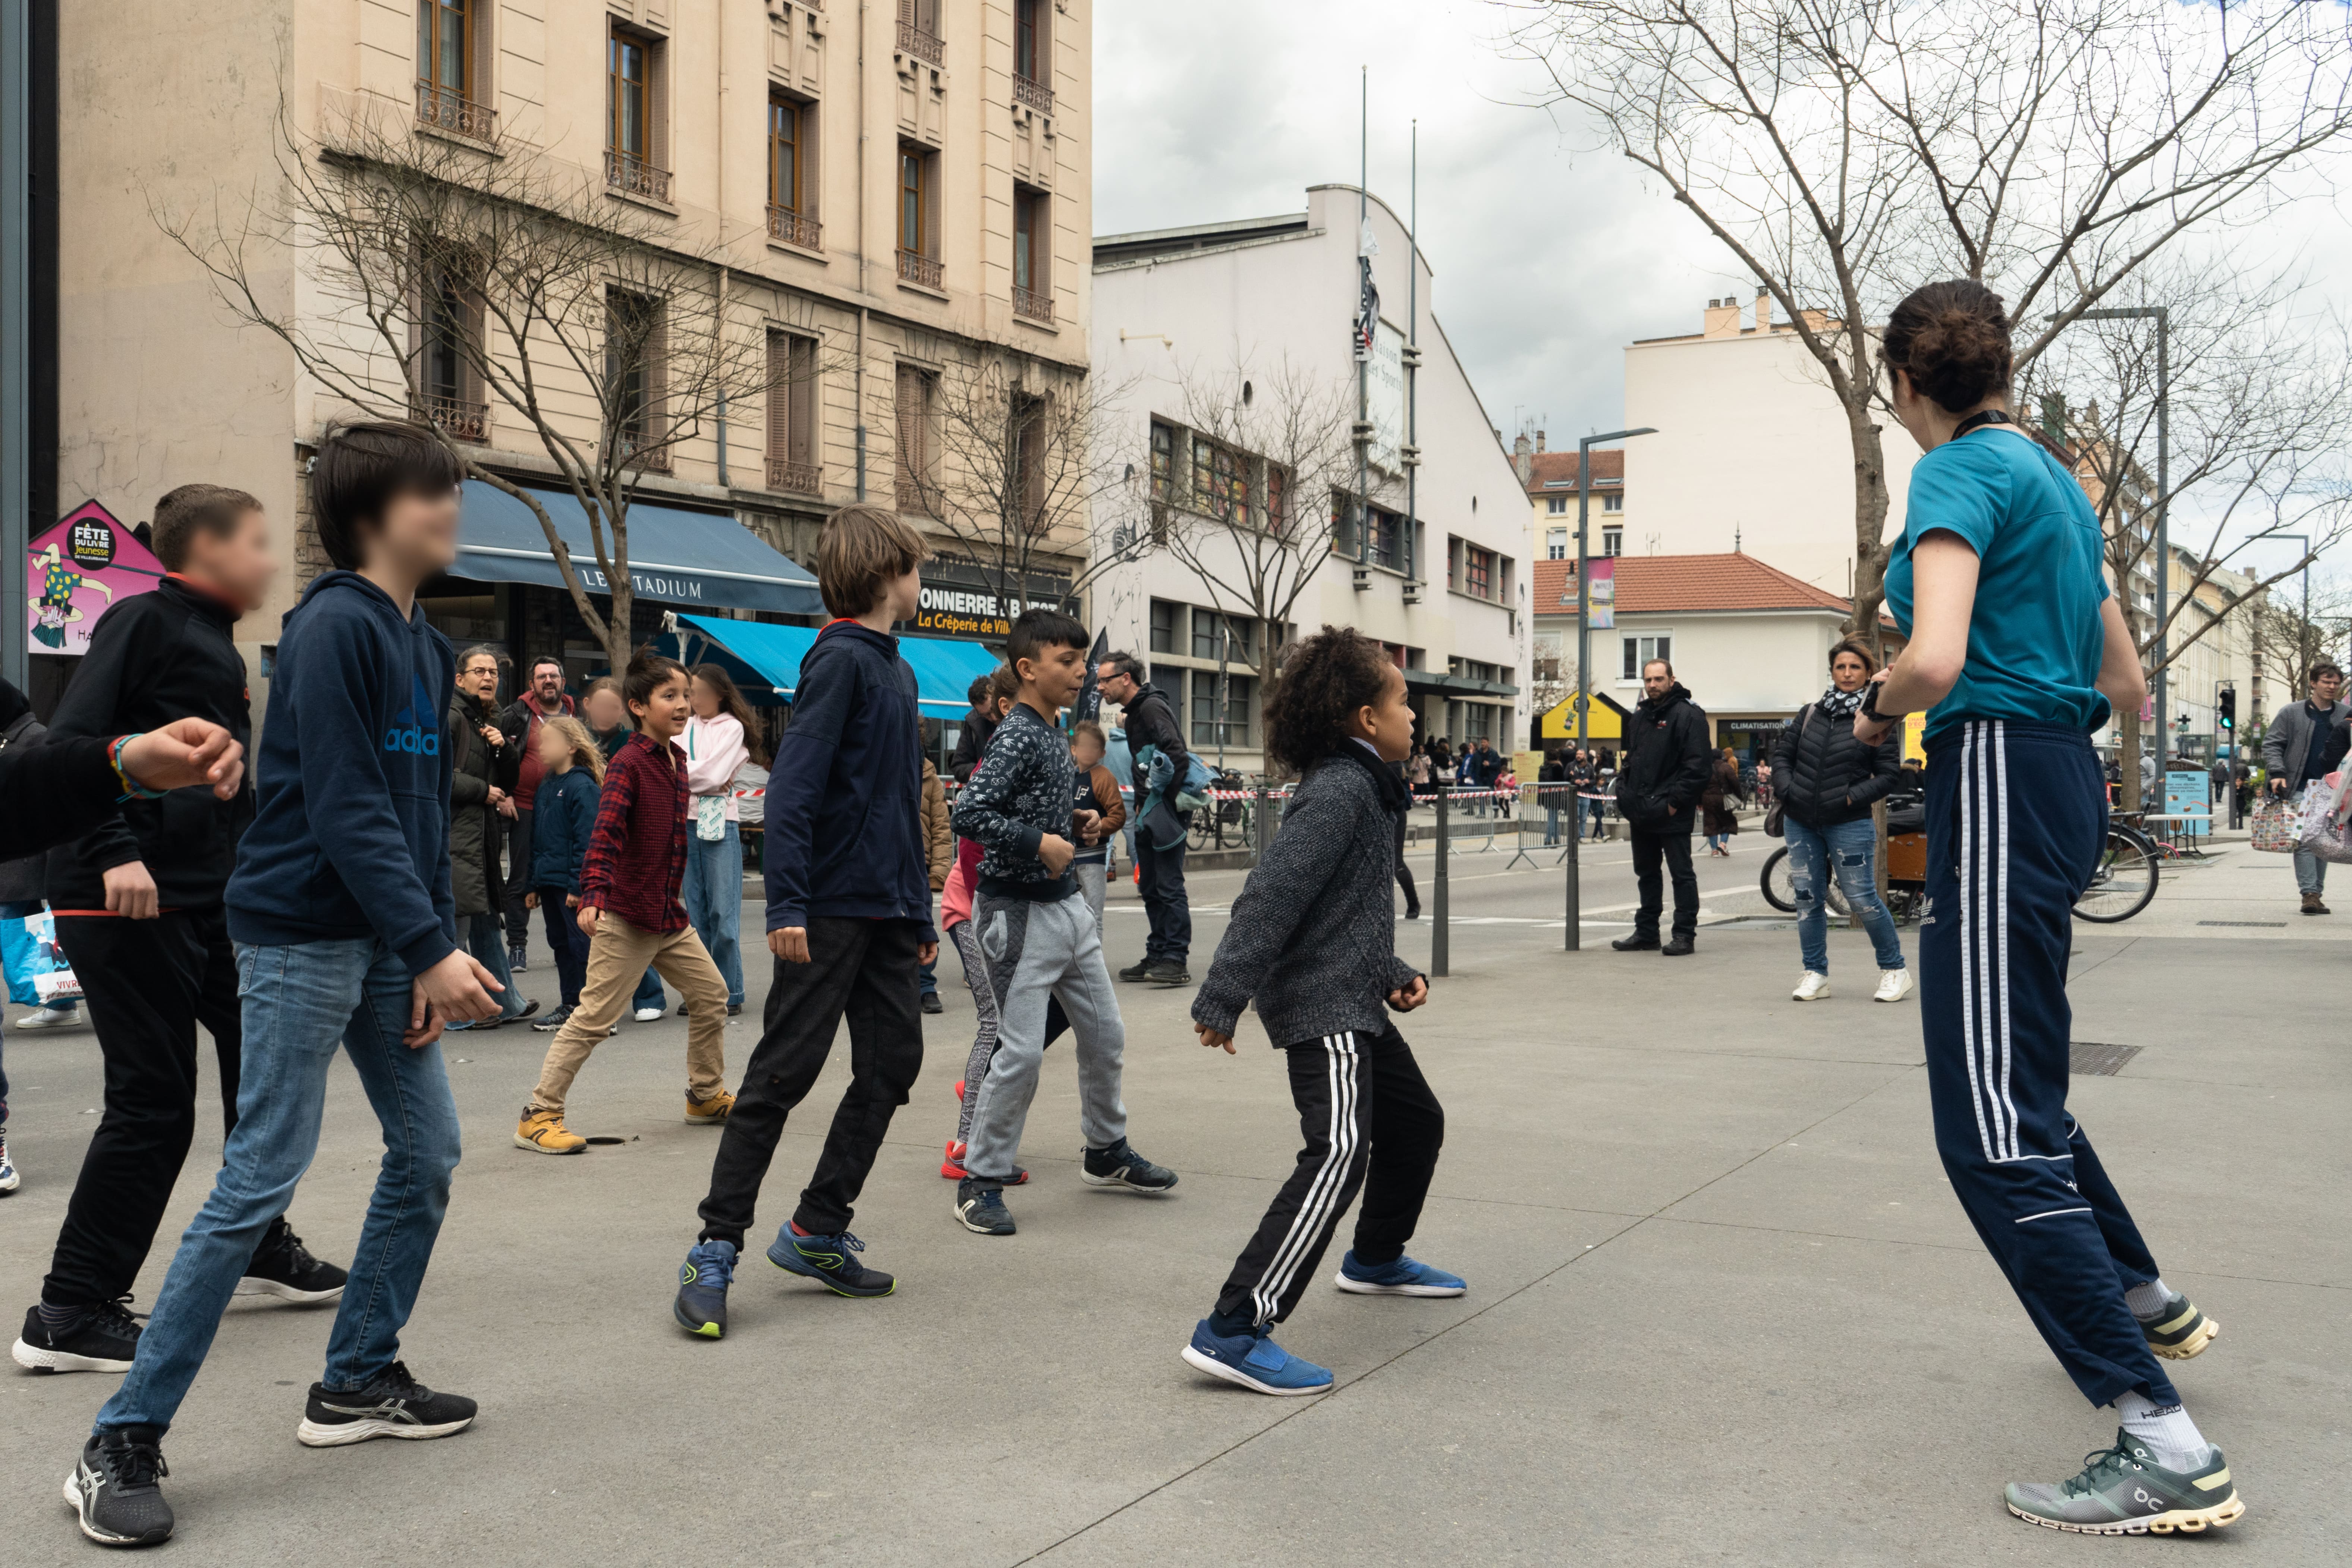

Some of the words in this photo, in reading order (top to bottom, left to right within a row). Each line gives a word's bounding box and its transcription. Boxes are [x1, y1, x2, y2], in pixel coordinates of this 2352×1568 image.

[1373, 336, 1397, 364] Maison
[1368, 361, 1378, 377] des
[1382, 364, 1402, 392] Sports
[75, 523, 109, 541] FÊTE
[74, 545, 109, 556] Jeunesse
[87, 540, 109, 548] LIVRE
[582, 570, 607, 587] LE
[633, 575, 701, 599] TADIUM
[919, 588, 997, 616] ONNERRE
[918, 611, 931, 627] La
[934, 613, 978, 634] Crêperie
[980, 618, 992, 633] de
[2141, 1404, 2181, 1419] HEAD
